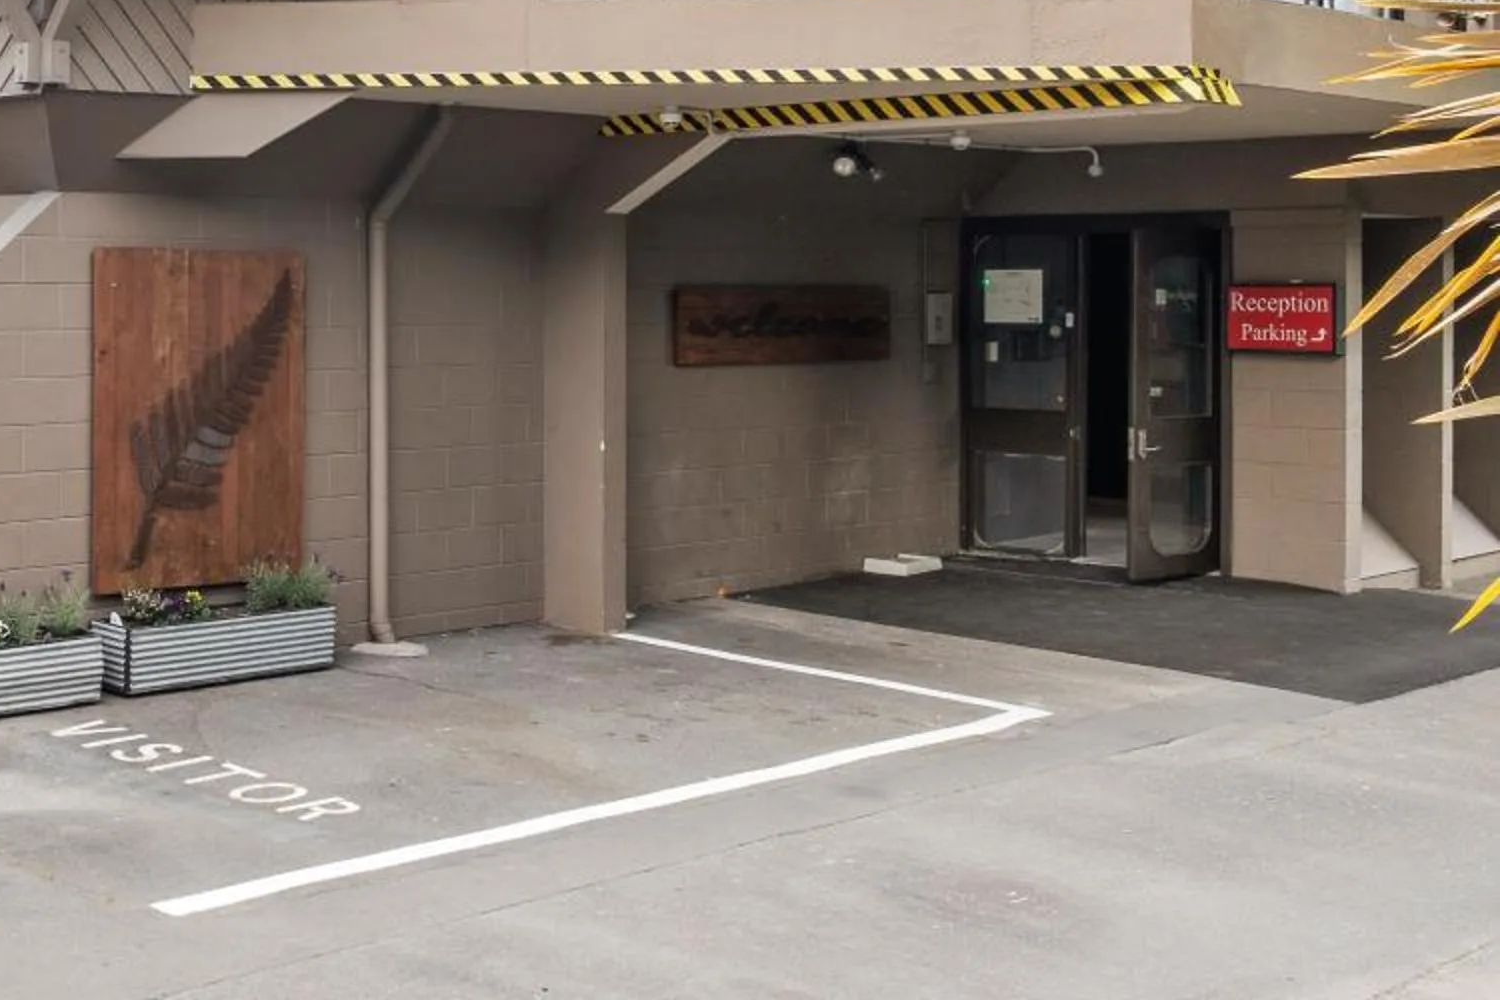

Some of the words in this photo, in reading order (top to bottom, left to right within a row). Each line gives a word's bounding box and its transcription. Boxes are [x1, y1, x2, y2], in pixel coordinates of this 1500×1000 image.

[1230, 291, 1330, 318] Reception
[1241, 323, 1308, 347] Parking
[52, 719, 361, 822] VISITOR
